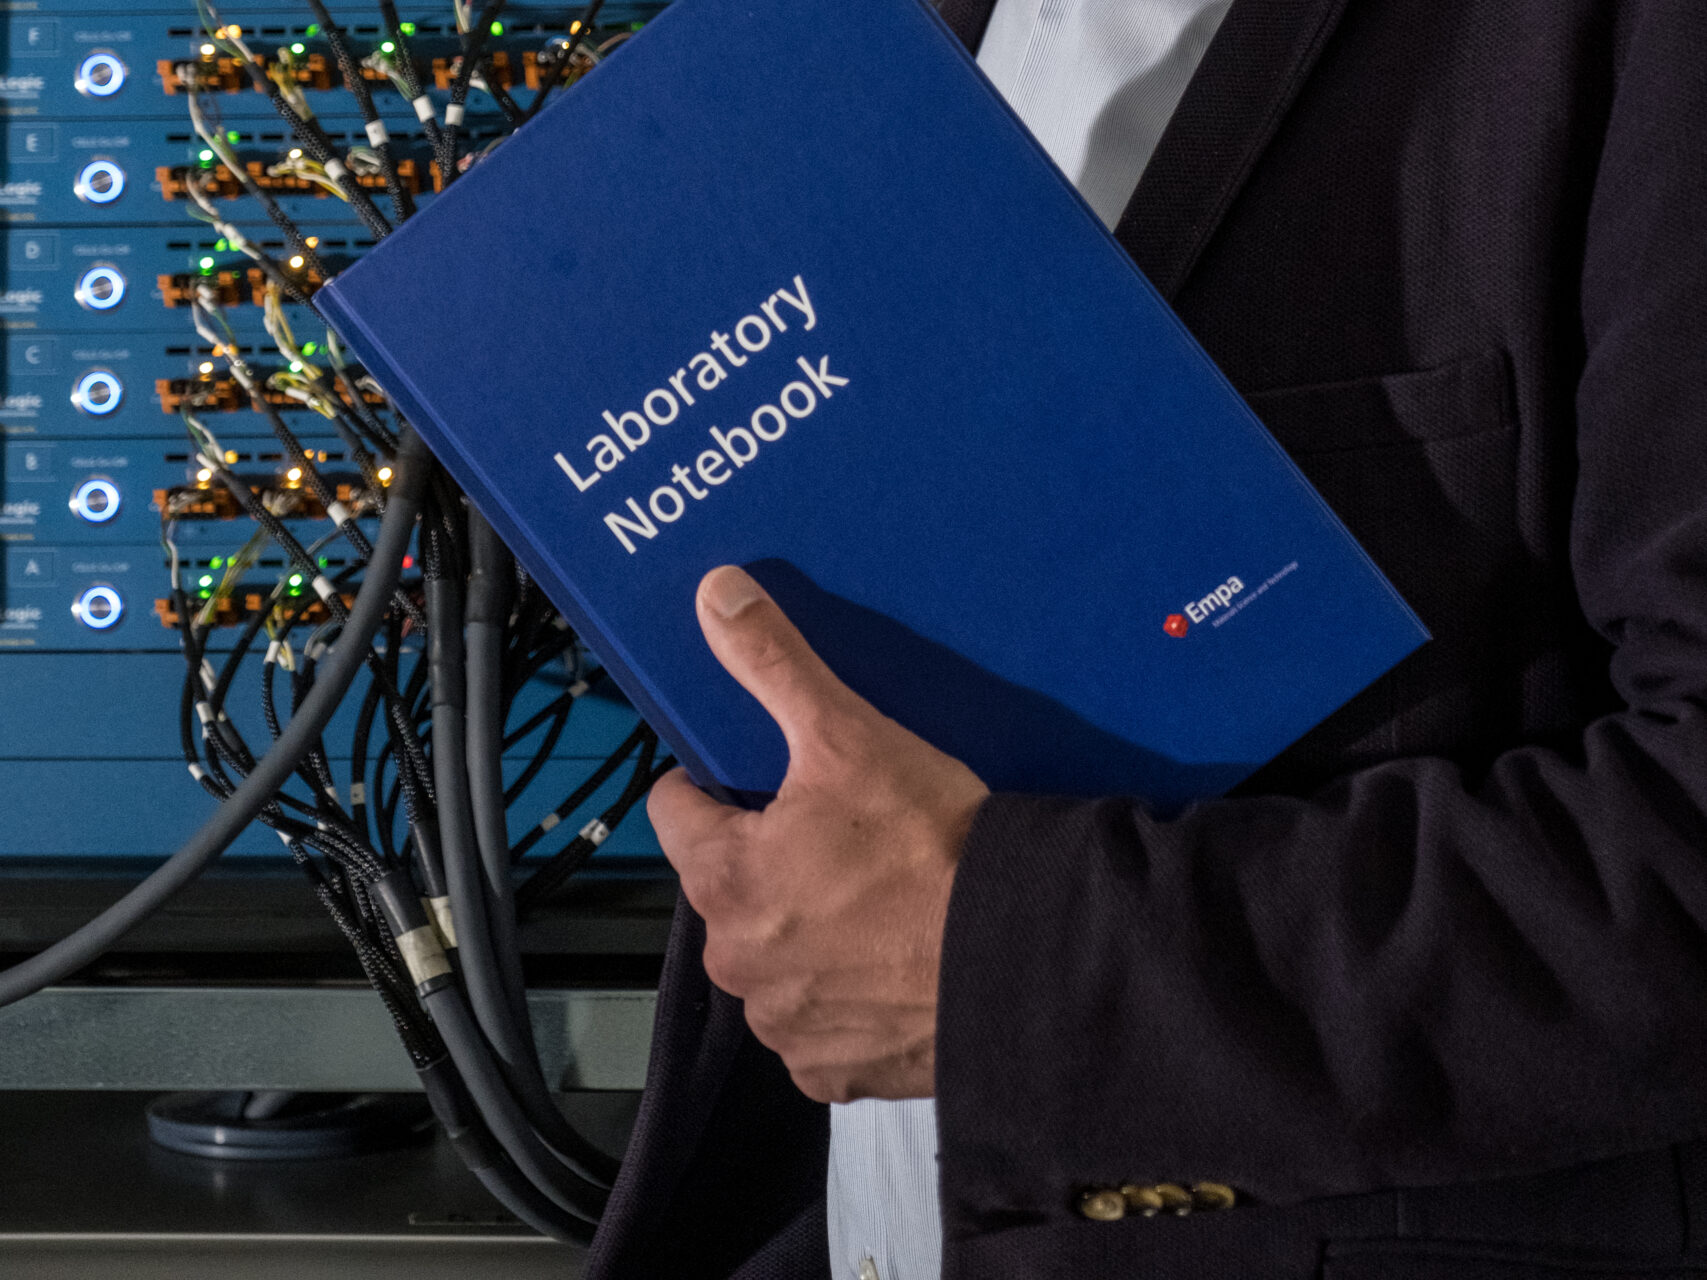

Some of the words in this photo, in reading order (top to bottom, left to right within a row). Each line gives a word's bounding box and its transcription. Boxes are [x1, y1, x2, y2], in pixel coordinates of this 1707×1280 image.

[553, 274, 817, 493] Laboratory
[603, 354, 850, 555] Notebook
[1184, 575, 1245, 625] Empa
